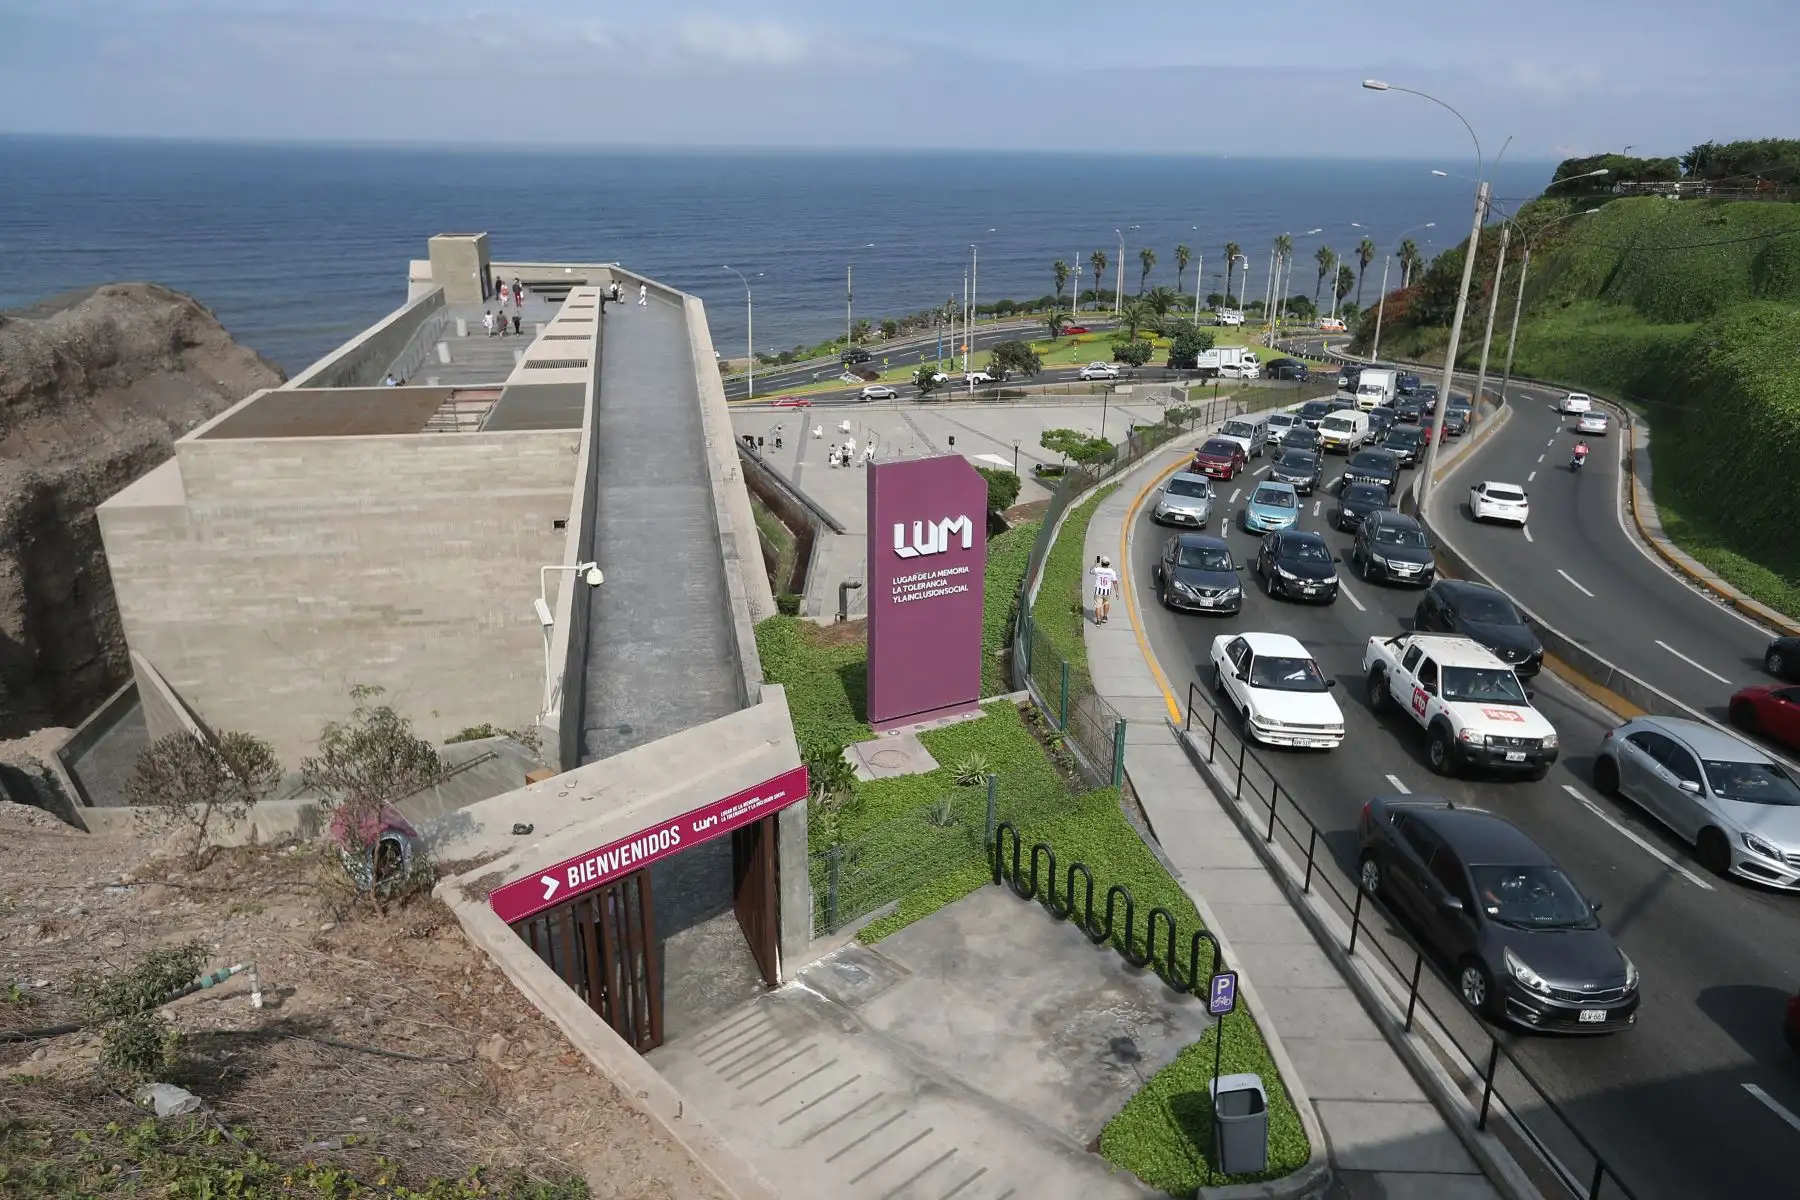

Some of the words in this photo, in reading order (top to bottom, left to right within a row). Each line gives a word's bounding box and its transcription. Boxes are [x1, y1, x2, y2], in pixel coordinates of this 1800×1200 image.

[893, 514, 973, 559] LUM
[893, 574, 917, 585] LUGAR
[918, 572, 927, 581] DE
[927, 571, 937, 579] LA
[937, 566, 969, 578] MEMORIA
[892, 586, 902, 595] LA
[903, 579, 948, 592] TOLERANCIA
[907, 588, 945, 601] INCLUSION
[944, 584, 969, 595] SOCIAL
[692, 815, 718, 833] LUM
[567, 825, 681, 888] BIENVENIDOS
[1217, 978, 1230, 995] P
